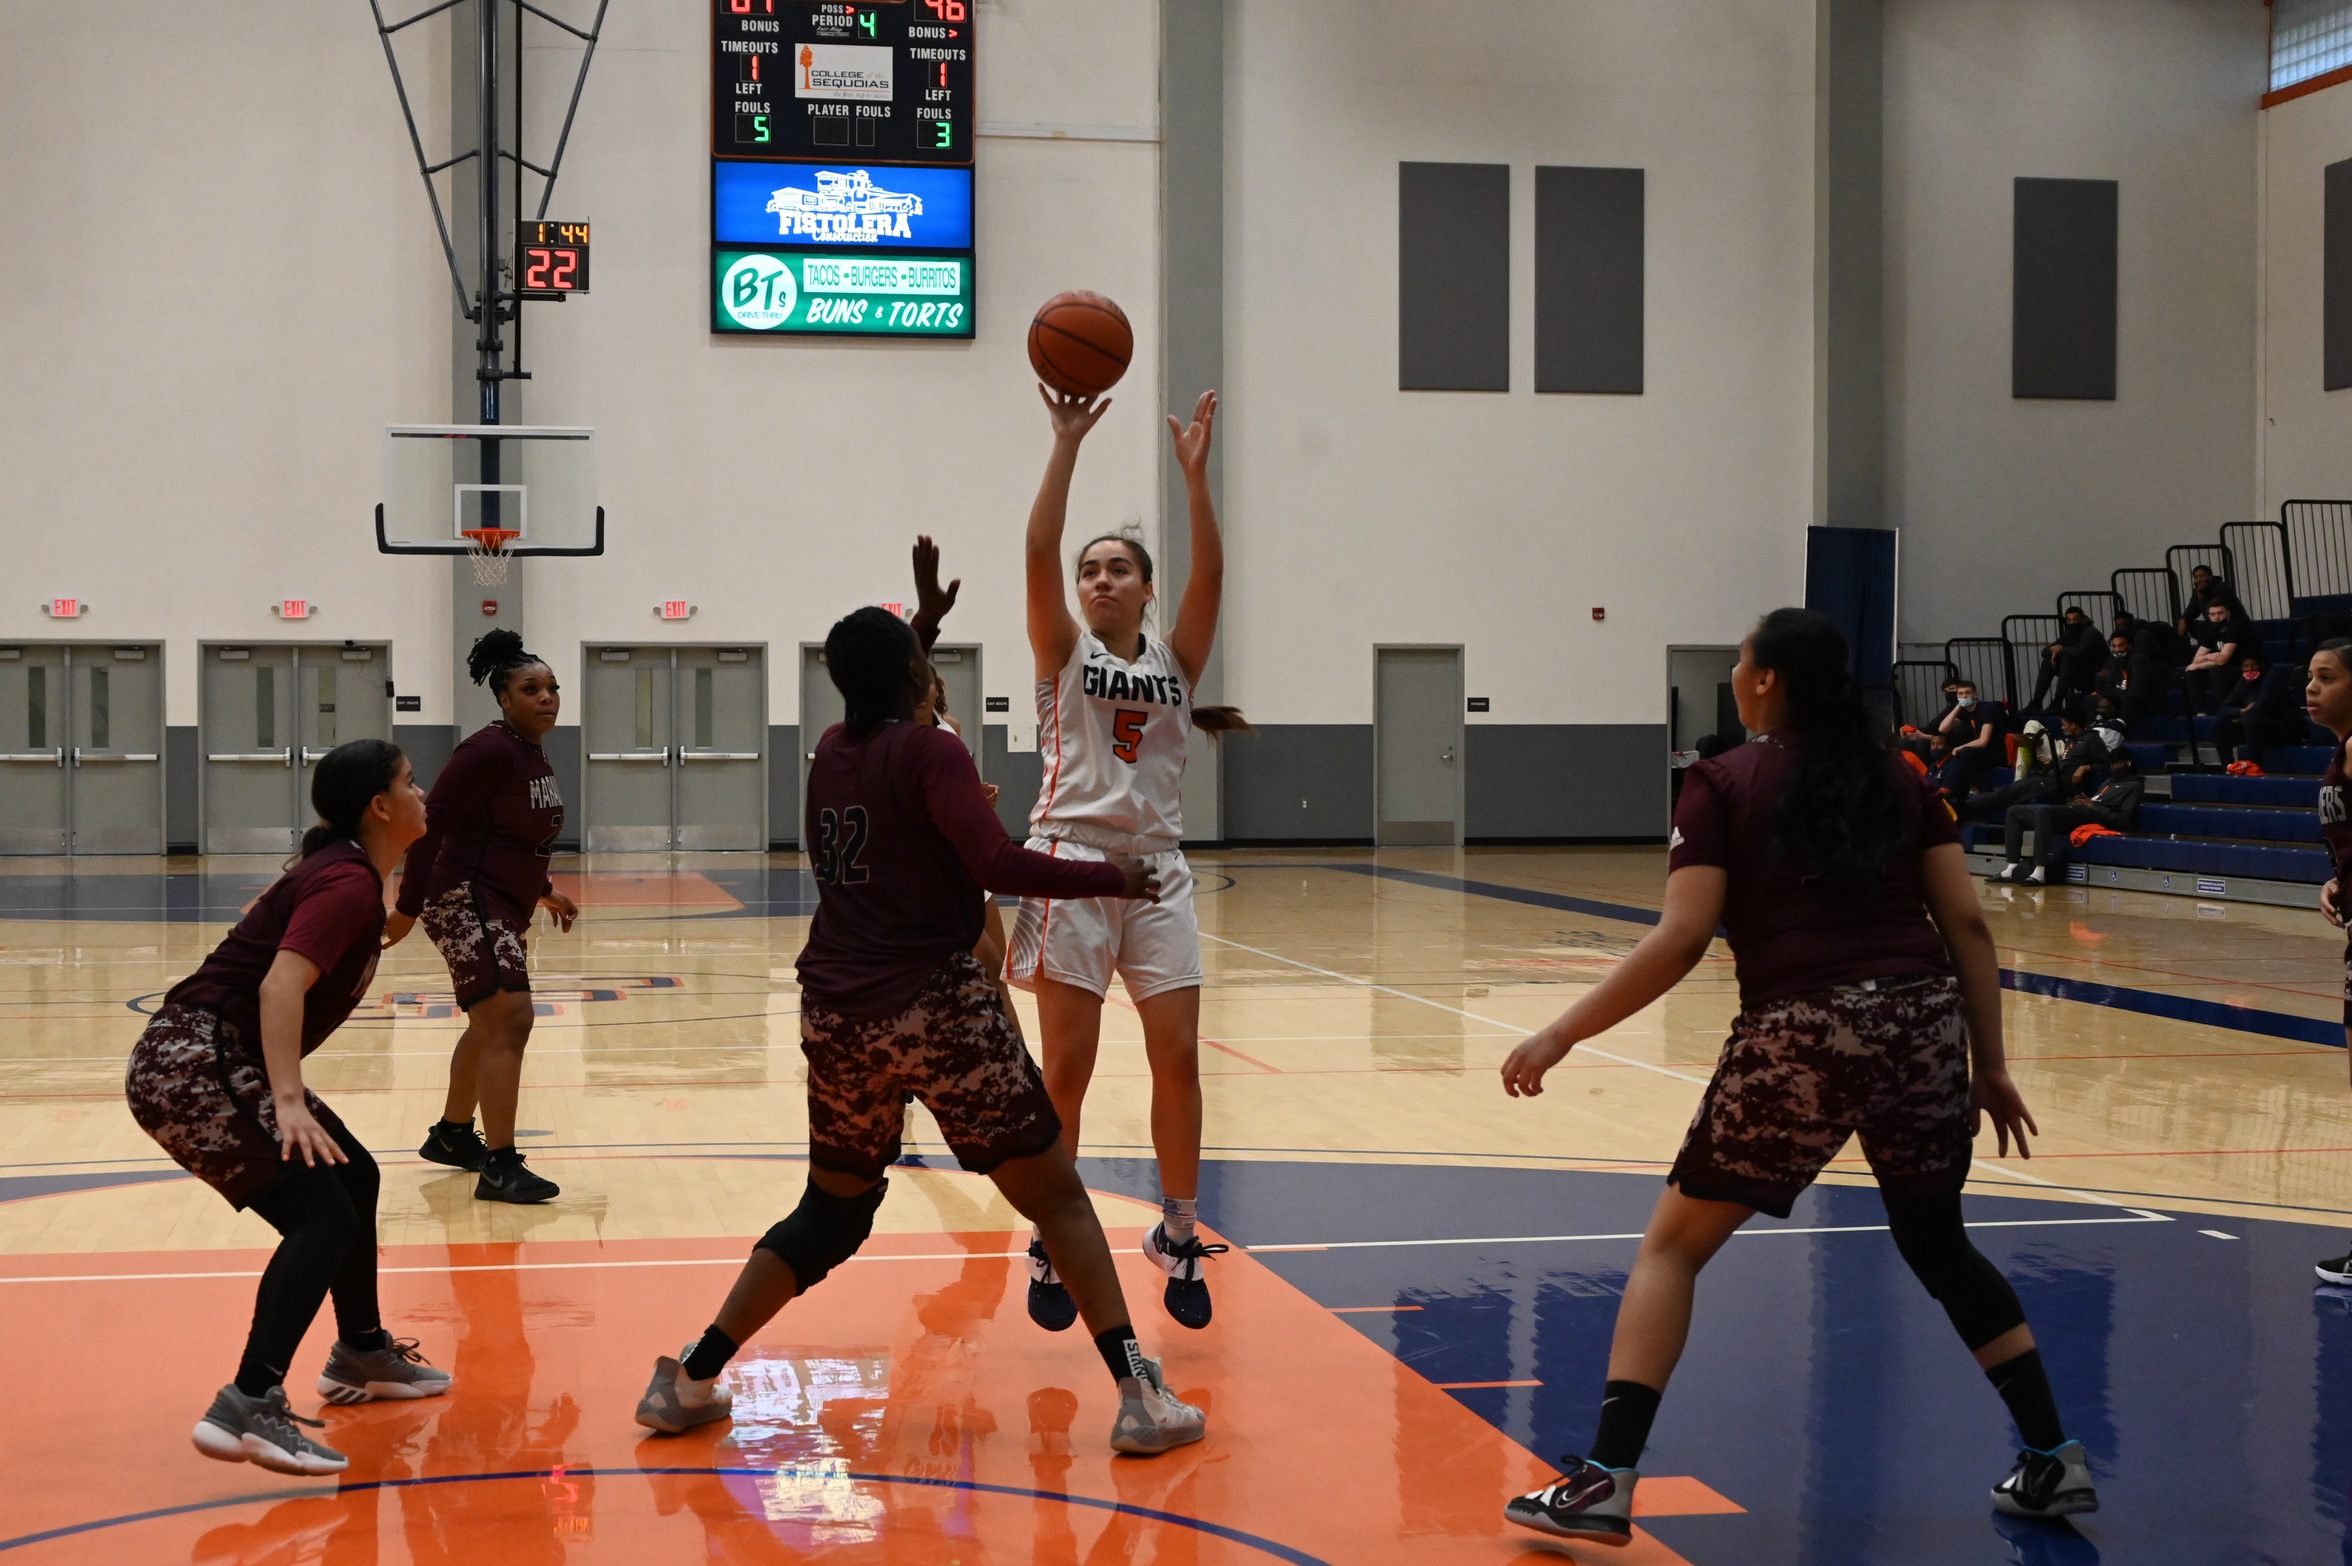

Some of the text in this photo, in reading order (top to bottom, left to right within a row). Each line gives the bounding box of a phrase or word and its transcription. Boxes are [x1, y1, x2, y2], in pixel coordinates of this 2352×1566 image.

[821, 4, 844, 13] POSS
[741, 20, 779, 32] BONUS
[812, 14, 853, 27] PERIOD
[860, 12, 875, 37] 4
[908, 26, 946, 38] BONUS
[721, 40, 779, 54] TIMEOUTS
[910, 47, 966, 60] TIMEOUTS
[751, 55, 758, 81] 1
[811, 70, 864, 79] COLLEGE
[940, 62, 946, 87] 1
[735, 83, 762, 94] LEFT
[812, 78, 889, 88] SEQUOIAS
[925, 89, 951, 101] LEFT
[735, 101, 771, 113] FOULS
[808, 104, 891, 117] PLAYER FOULS
[917, 107, 952, 119] FOULS
[754, 116, 769, 141] 5
[935, 122, 950, 147] 3
[779, 211, 912, 239] FISTOLERA
[527, 249, 576, 289] 22
[808, 265, 956, 288] TACOS BURGERS BURRITOS
[738, 311, 783, 319] DRIVE THRU
[806, 298, 964, 328] BUNS & TORTS
[55, 599, 77, 616] EXIT
[284, 600, 306, 617] EXIT
[665, 601, 687, 617] EXIT
[1083, 664, 1182, 707] GIANTS
[1112, 708, 1149, 764] 5
[2318, 785, 2347, 825] ERS
[814, 805, 869, 885] 32
